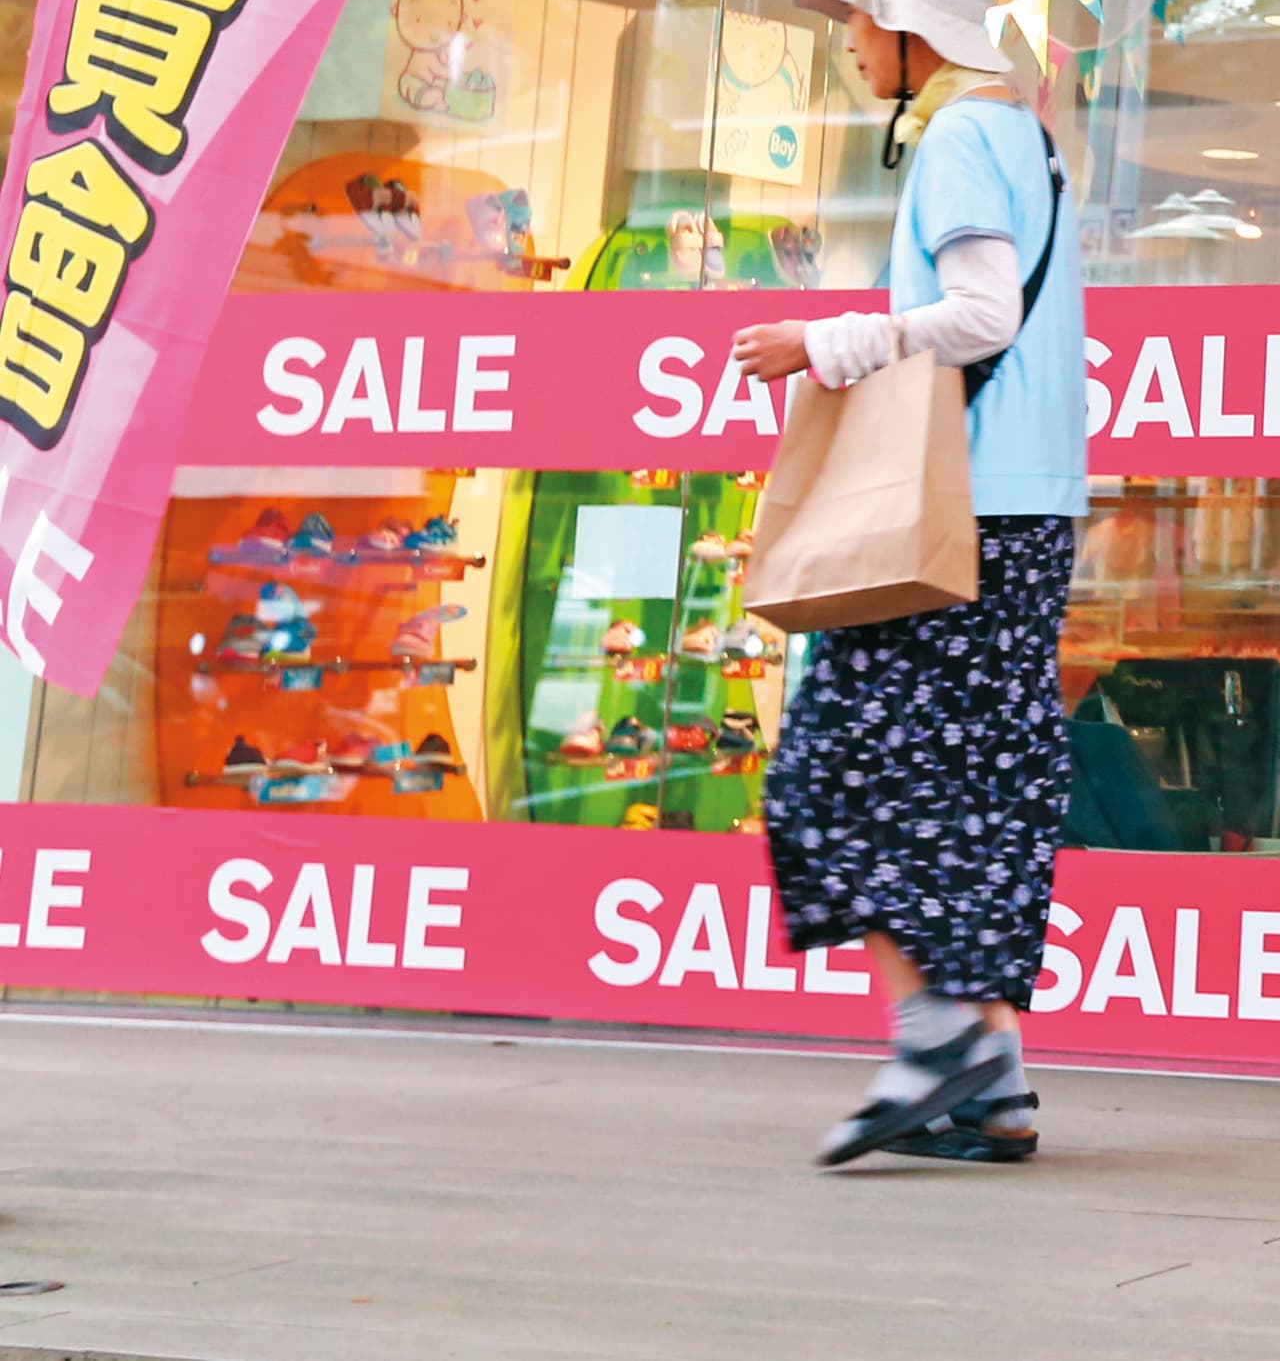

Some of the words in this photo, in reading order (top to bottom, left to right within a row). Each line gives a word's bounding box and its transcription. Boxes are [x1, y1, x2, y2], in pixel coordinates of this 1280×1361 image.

[770, 132, 795, 161] Boy
[256, 334, 517, 437] SALE
[632, 336, 803, 438] SA
[0, 848, 91, 950] E
[200, 857, 470, 971] SALE
